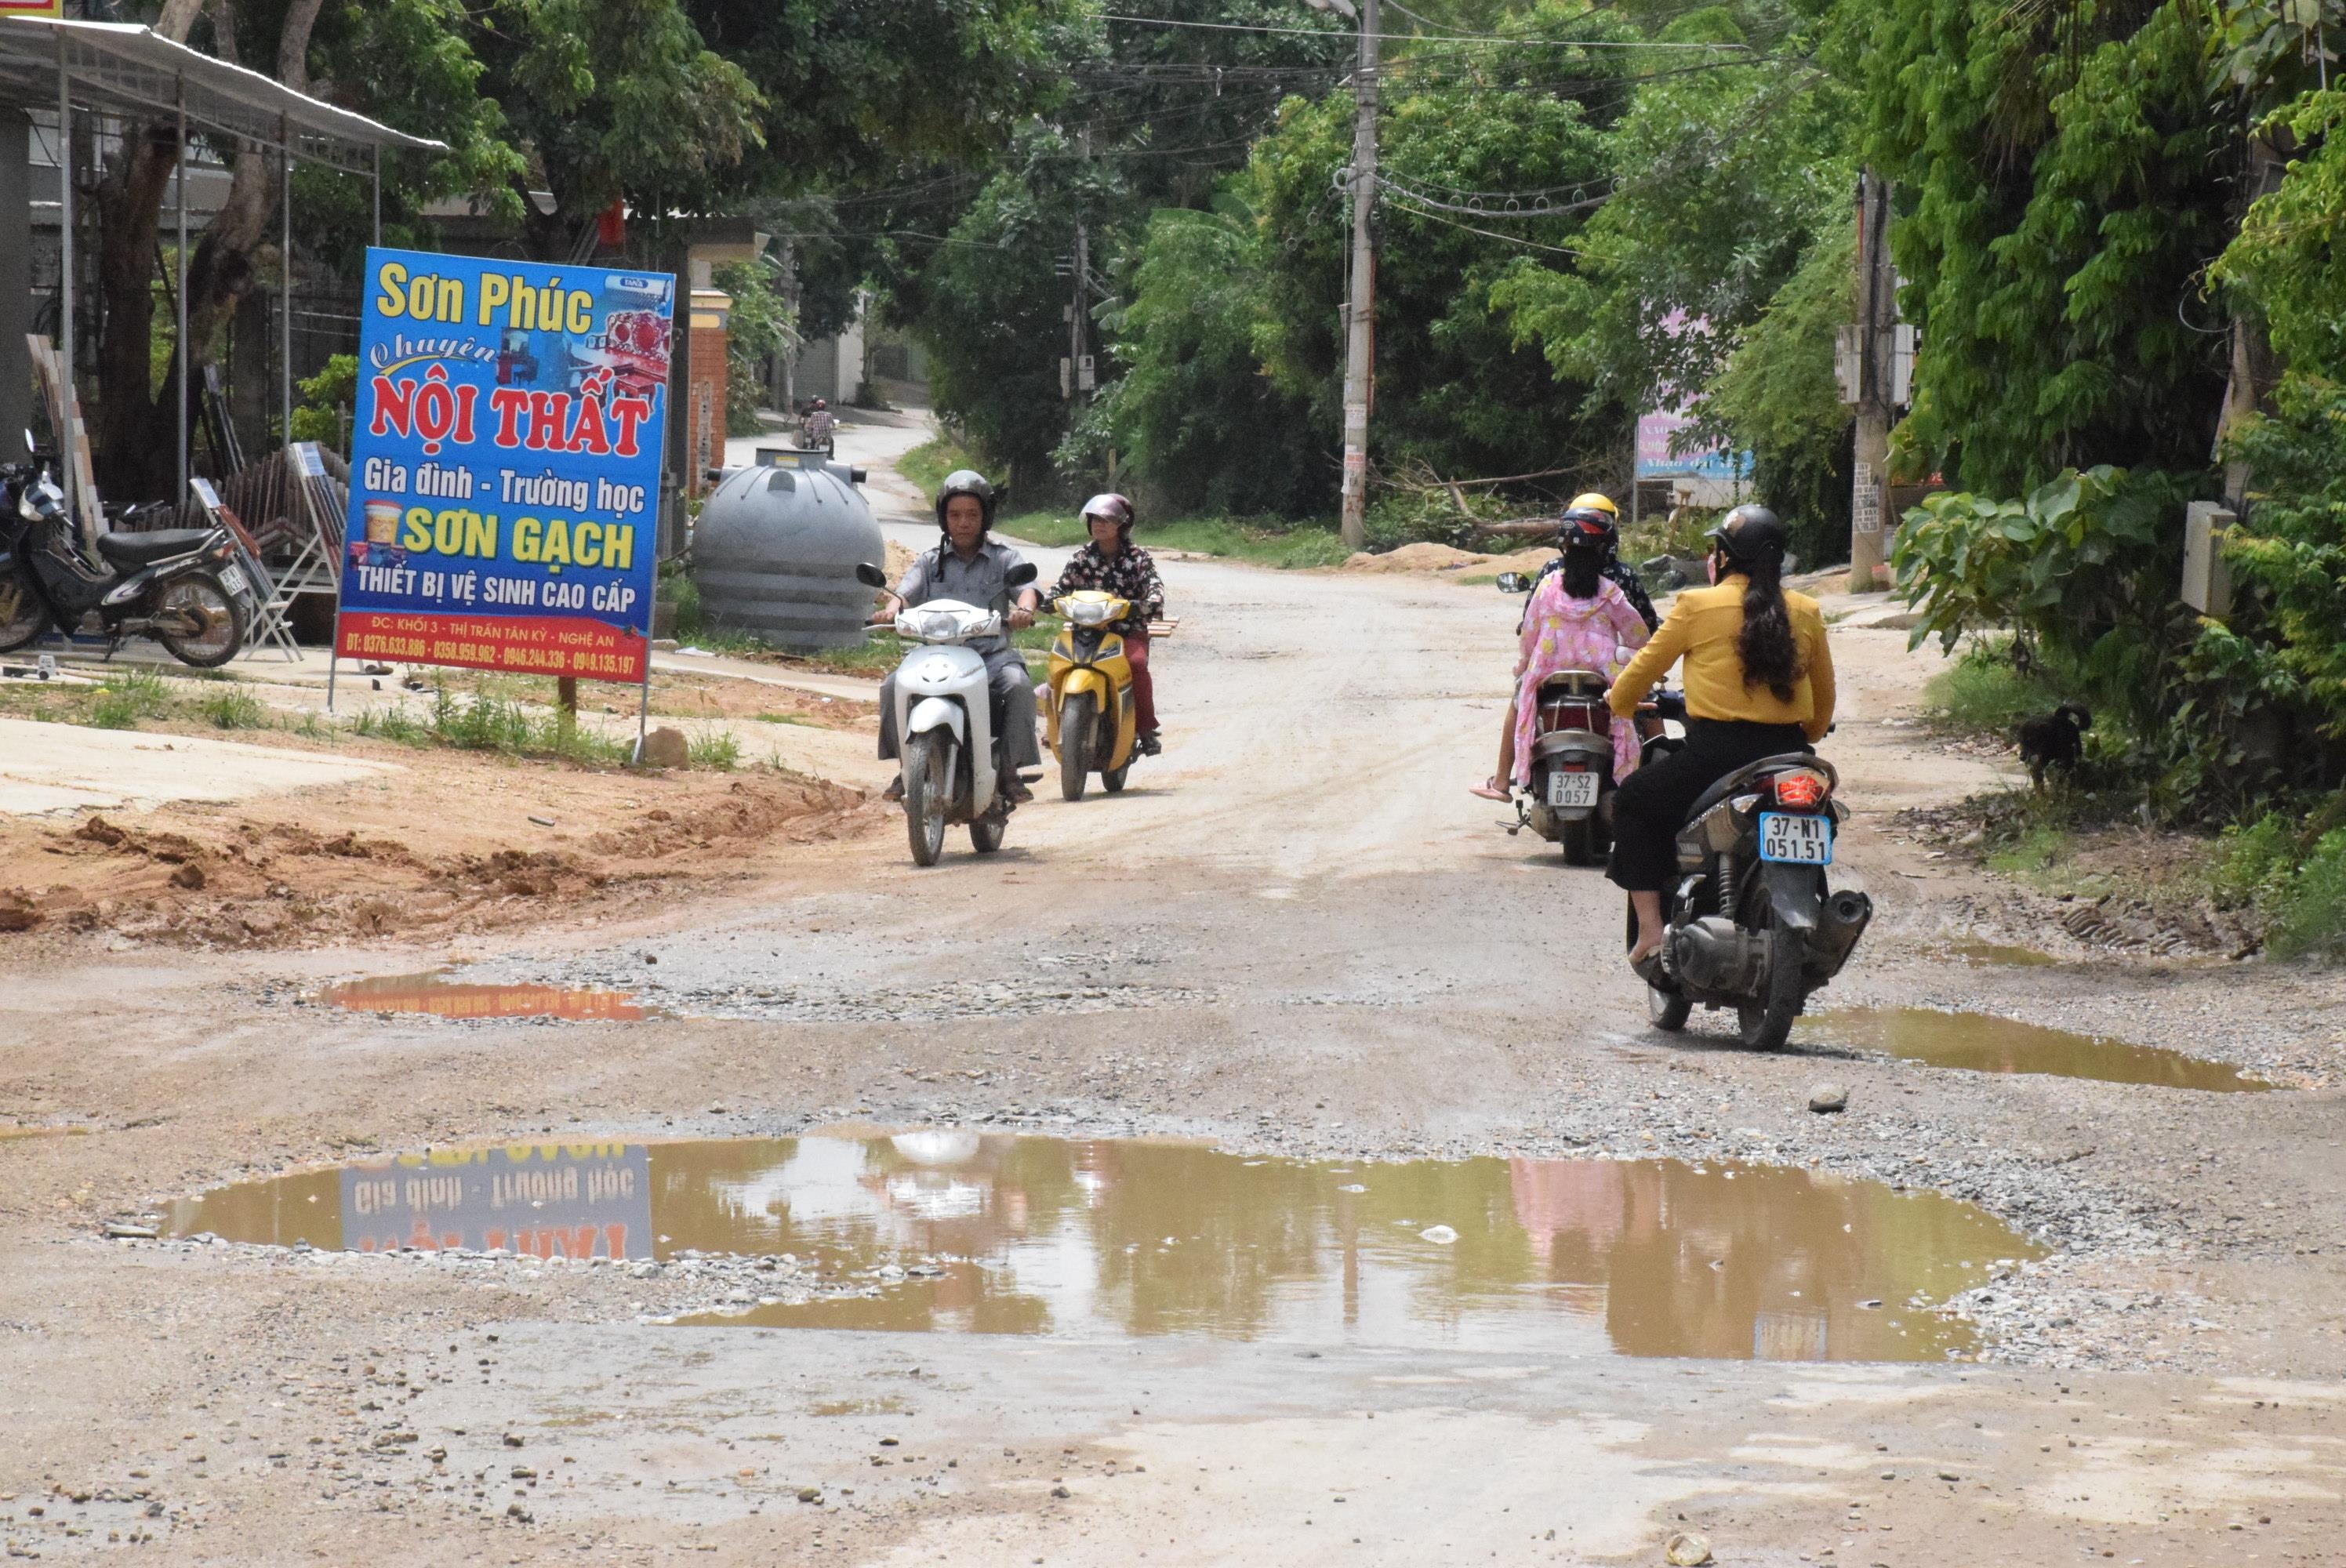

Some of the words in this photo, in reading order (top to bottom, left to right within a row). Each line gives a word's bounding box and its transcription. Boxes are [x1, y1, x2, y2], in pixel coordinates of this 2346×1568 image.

[377, 262, 464, 323] Sơn
[478, 273, 594, 334] Phúc
[370, 333, 496, 369] Chuyên
[369, 363, 479, 456] NỘI
[491, 367, 650, 457] THẤT
[364, 456, 407, 493] Gia
[415, 463, 473, 499] đình
[499, 468, 589, 512] Trường
[597, 477, 645, 518] học
[403, 506, 499, 560] SƠN
[512, 516, 634, 575] GẠCH
[358, 559, 417, 596] THIẾT
[423, 573, 444, 603] BỊ
[451, 569, 477, 606] VỆ
[483, 576, 536, 606] SINH
[542, 581, 585, 608] CAO
[591, 578, 636, 613] CẤP
[372, 615, 394, 630] ĐC:
[398, 615, 427, 633] KHỐI
[430, 621, 438, 633] 3
[450, 622, 467, 638] THỊ
[471, 622, 500, 639] TRẤN
[504, 625, 528, 641] TÂN
[532, 626, 547, 642] KỲ
[558, 631, 594, 648] NGHỆ
[597, 635, 615, 648] AN
[1556, 775, 1591, 789] 37-S2
[1556, 789, 1590, 804] 0057
[1771, 816, 1819, 839] 37-N1
[1766, 838, 1825, 861] 051.51
